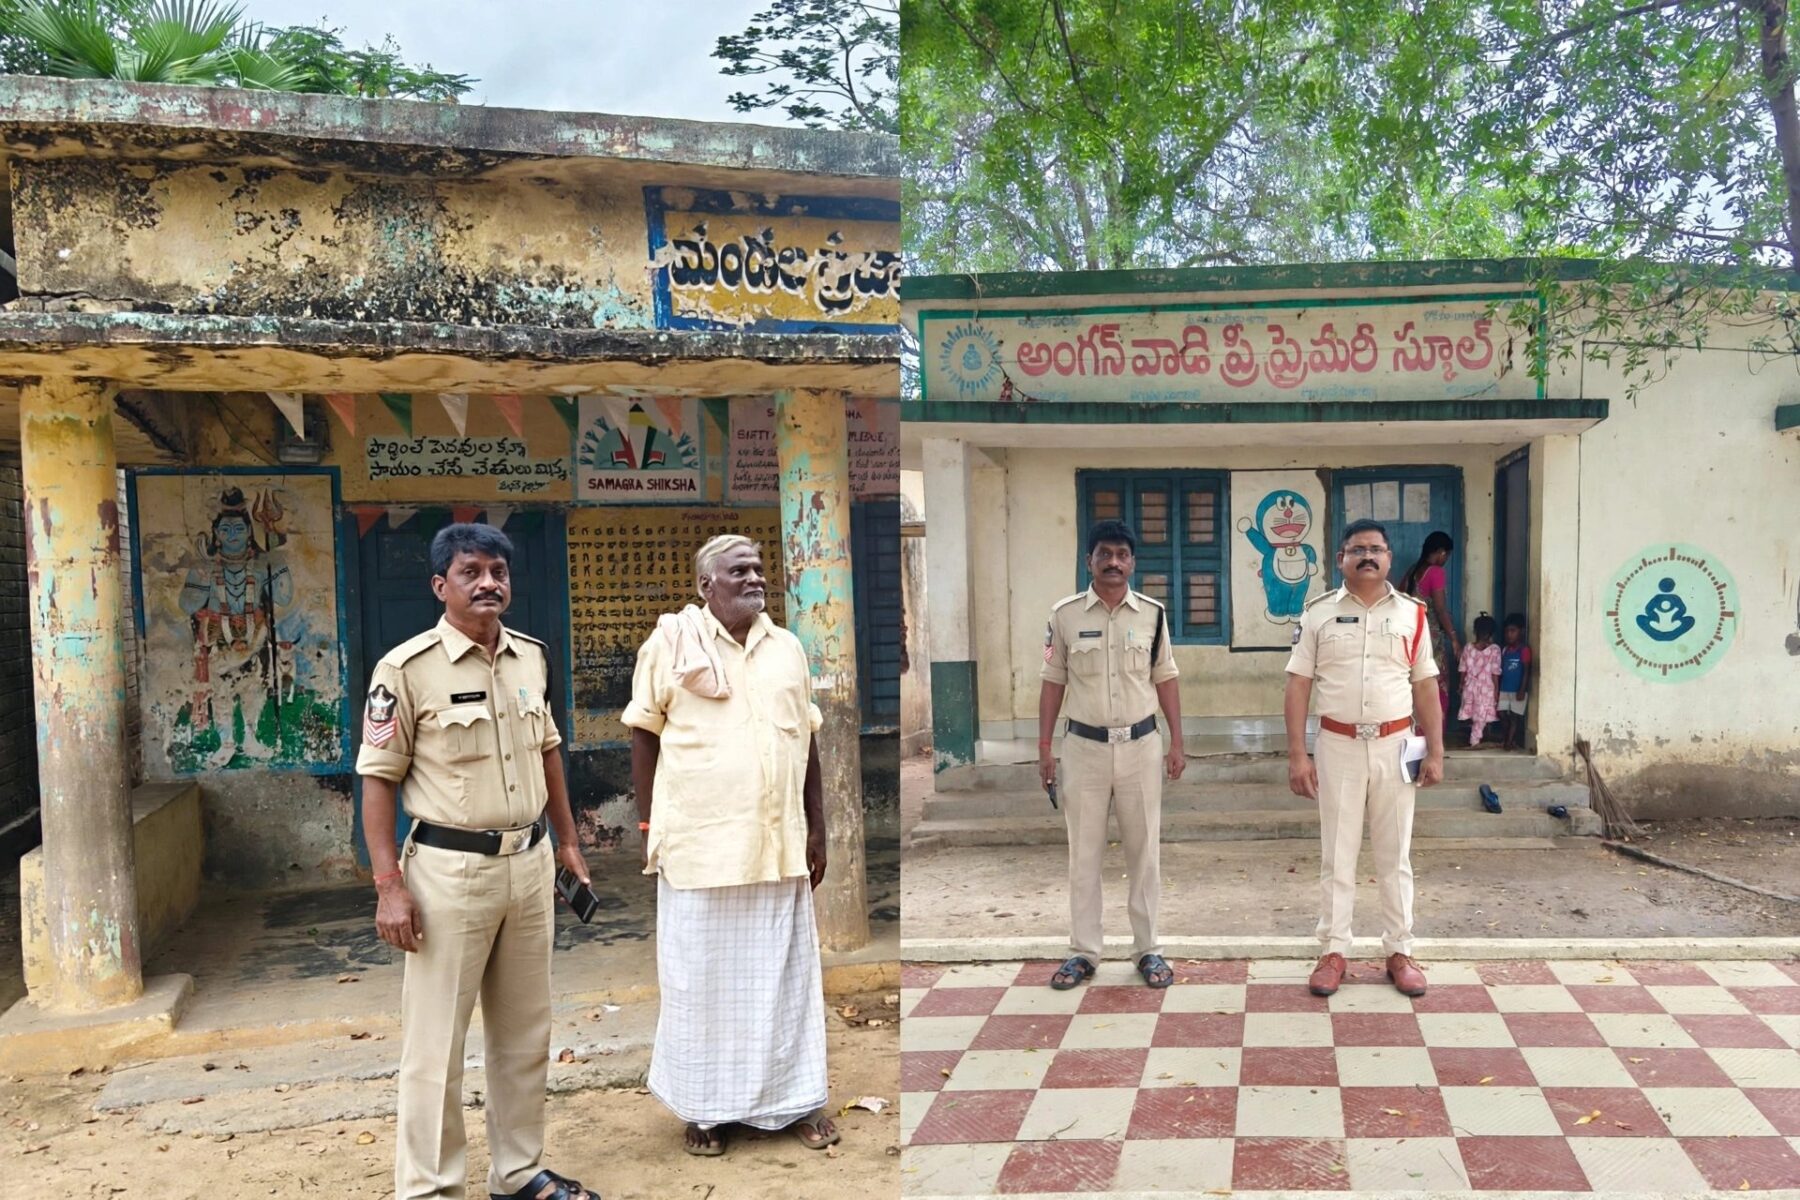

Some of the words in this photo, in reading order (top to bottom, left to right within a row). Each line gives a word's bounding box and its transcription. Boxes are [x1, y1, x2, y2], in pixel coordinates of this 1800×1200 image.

[1264, 322, 1378, 389] ప్రైమరీ
[1393, 319, 1493, 382] స్కూల్
[369, 460, 422, 481] సాయం
[588, 478, 643, 491] SAMAGRA
[647, 478, 697, 491] SHIKSHA
